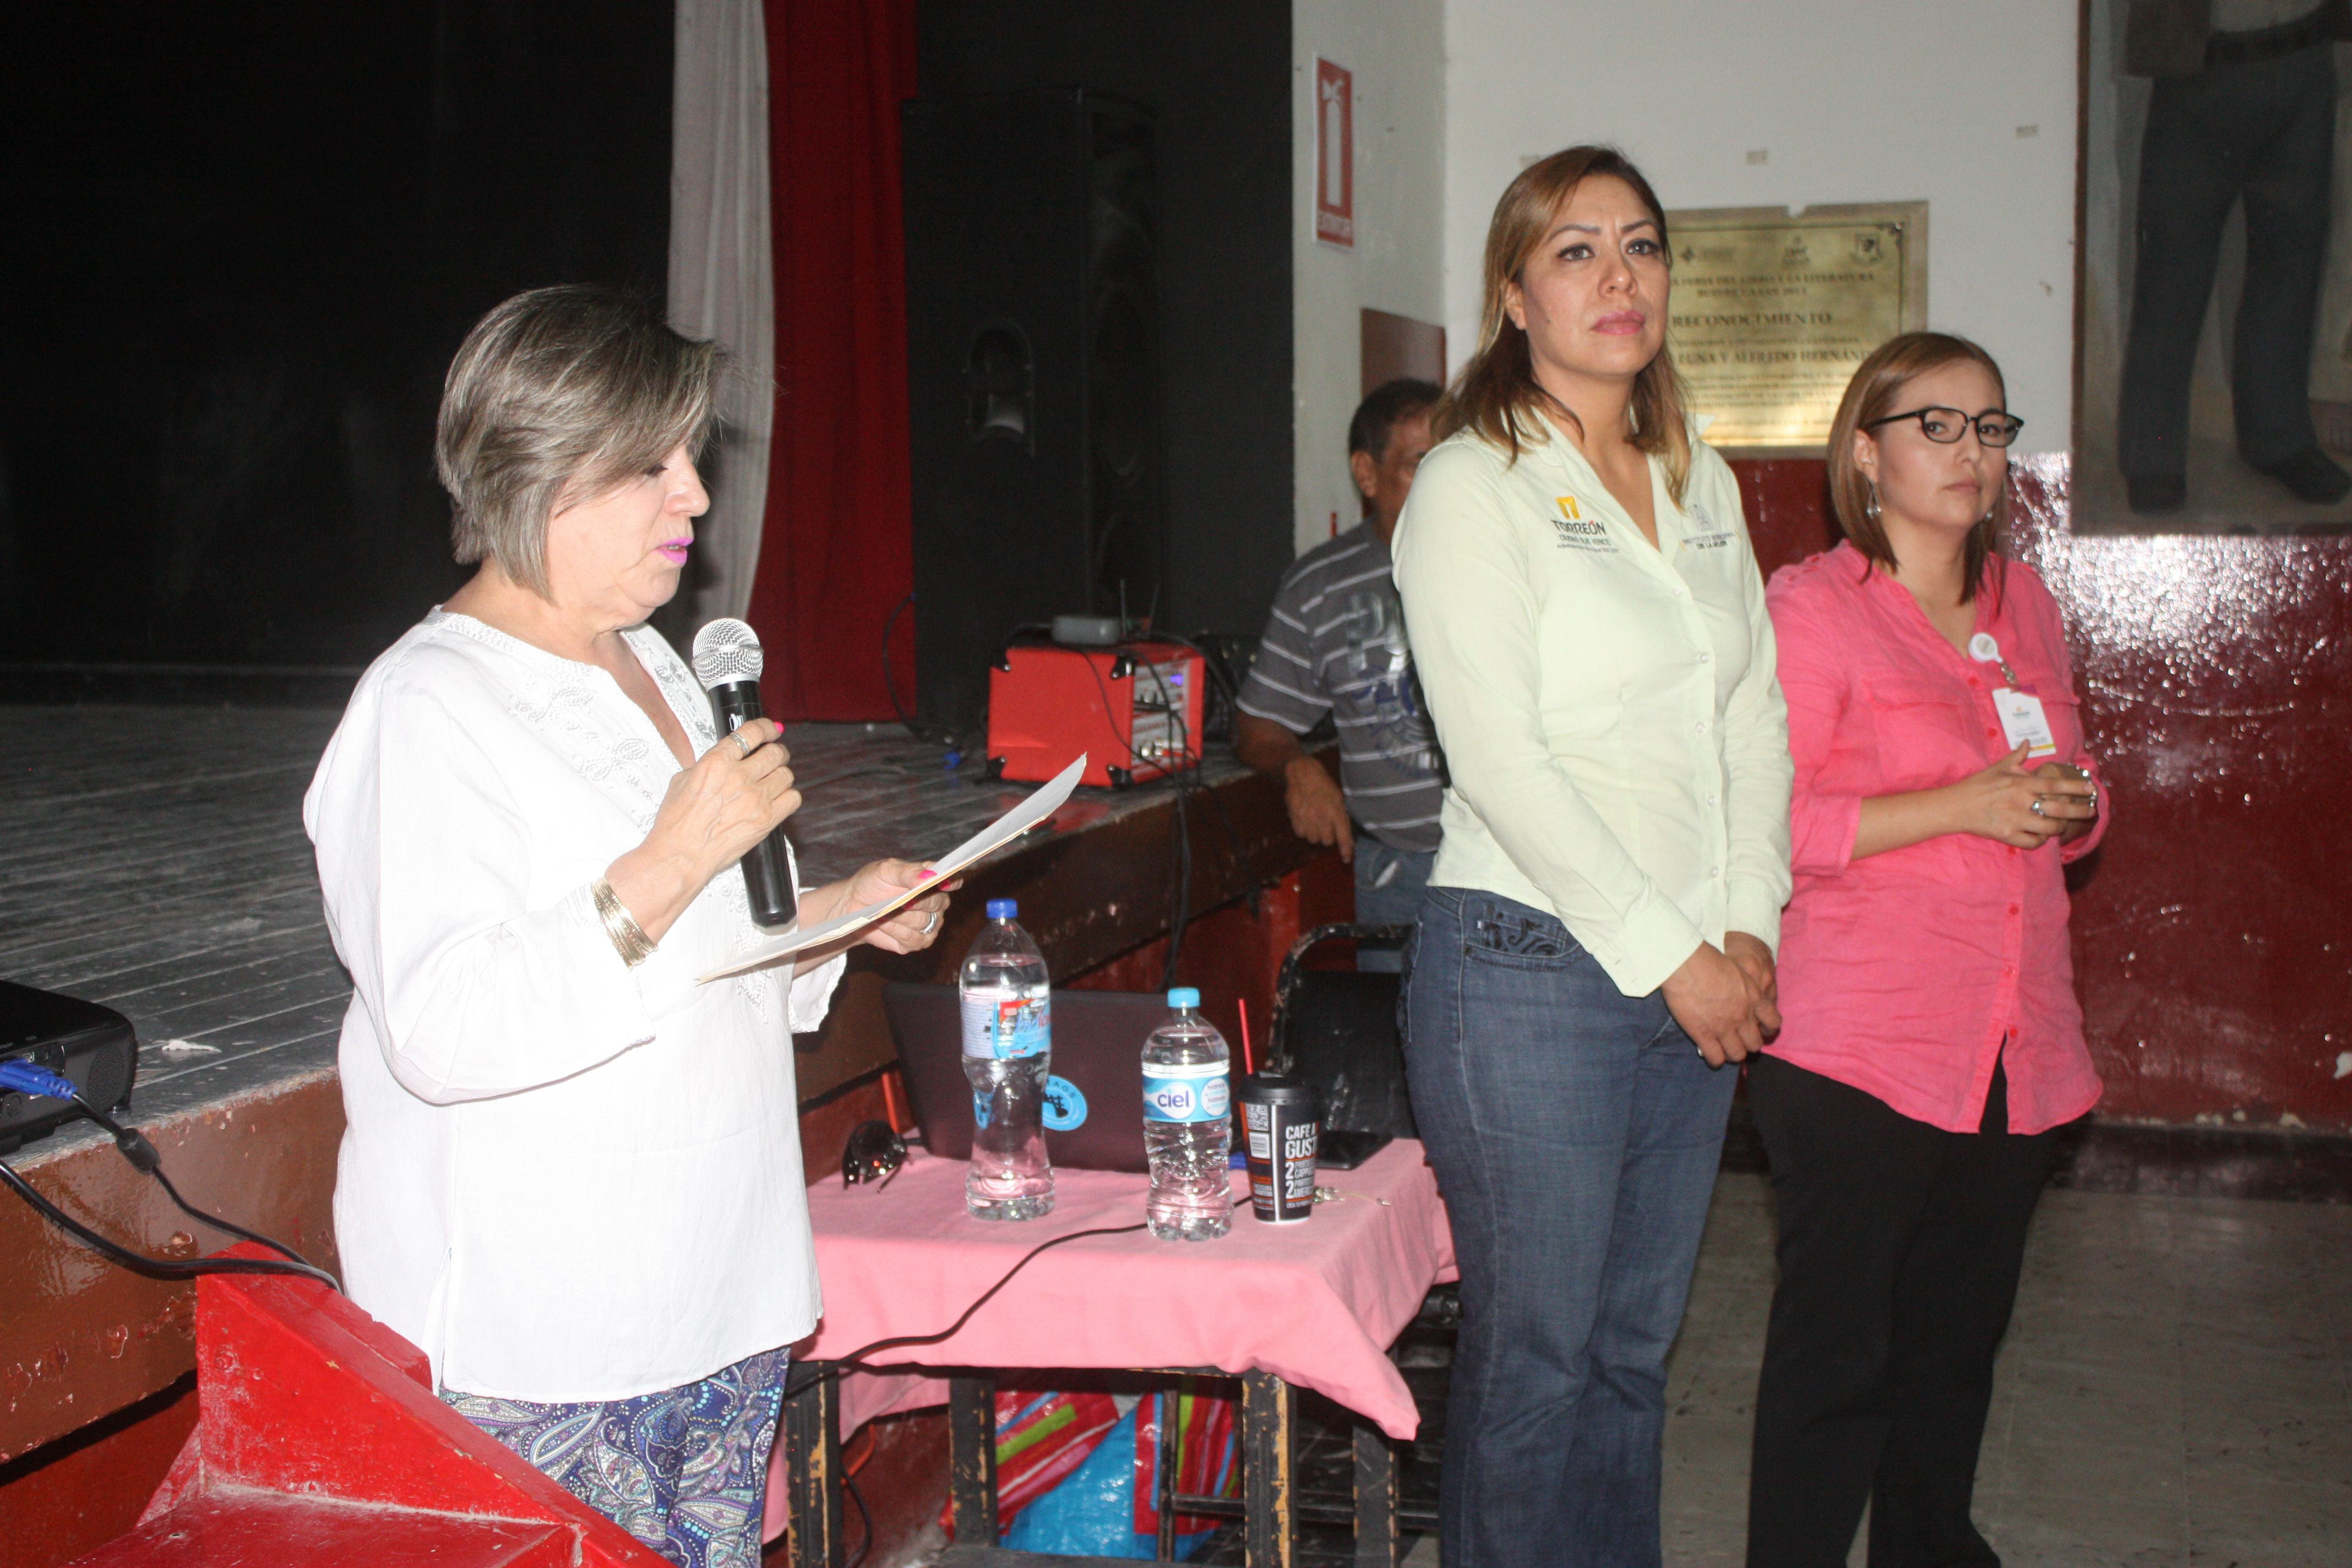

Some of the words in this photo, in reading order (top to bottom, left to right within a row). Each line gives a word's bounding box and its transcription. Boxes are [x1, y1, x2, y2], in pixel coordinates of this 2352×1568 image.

[1672, 311, 1832, 327] RECONOCIMIENTO
[1157, 1088, 1190, 1108] ciel
[1285, 1124, 1310, 1140] CAFE
[1285, 1161, 1294, 1179] 2
[1286, 1180, 1294, 1199] 2
